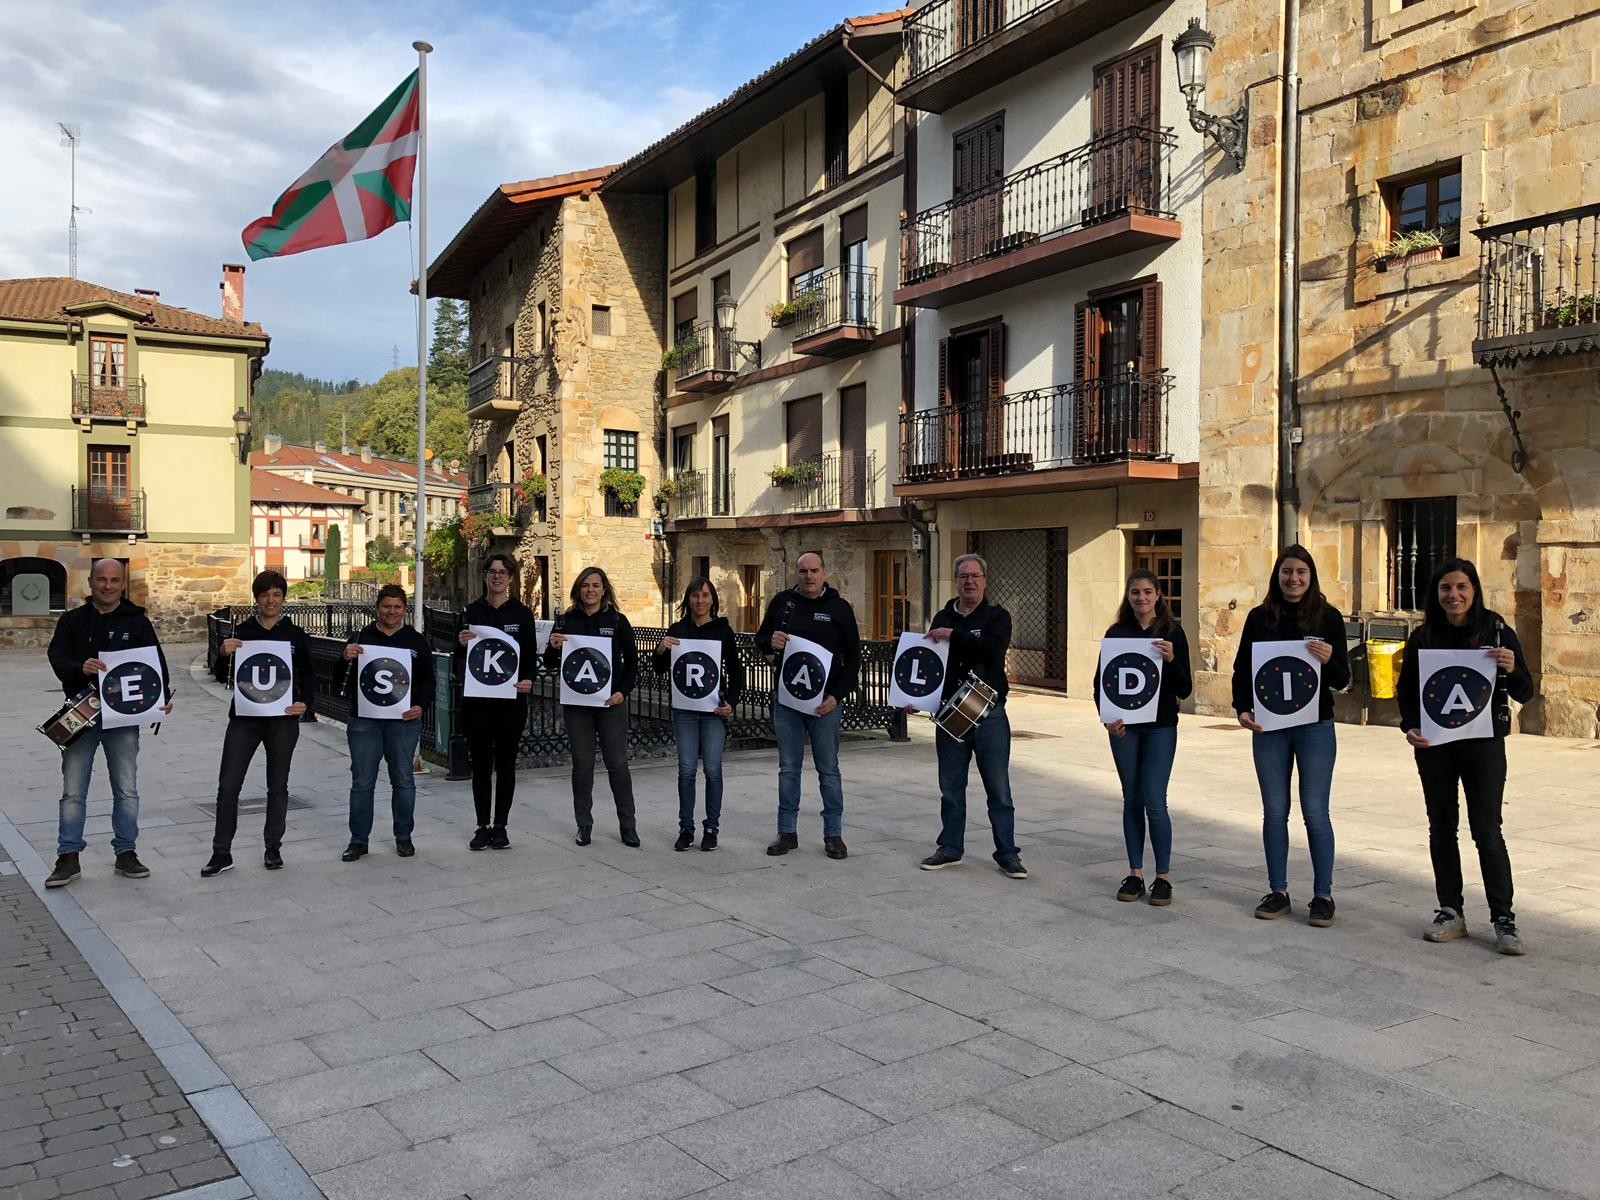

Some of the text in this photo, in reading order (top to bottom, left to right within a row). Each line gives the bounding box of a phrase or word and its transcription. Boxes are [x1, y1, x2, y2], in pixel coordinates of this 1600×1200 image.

[1145, 512, 1154, 521] 10
[483, 649, 506, 674] K
[573, 659, 599, 684] A
[909, 658, 927, 686] L
[119, 674, 144, 702] E
[251, 665, 277, 691] U
[373, 669, 394, 695] S
[685, 663, 705, 688] R
[790, 664, 812, 691] A
[1118, 667, 1146, 696] D
[1282, 671, 1293, 701] I
[1440, 683, 1475, 715] A
